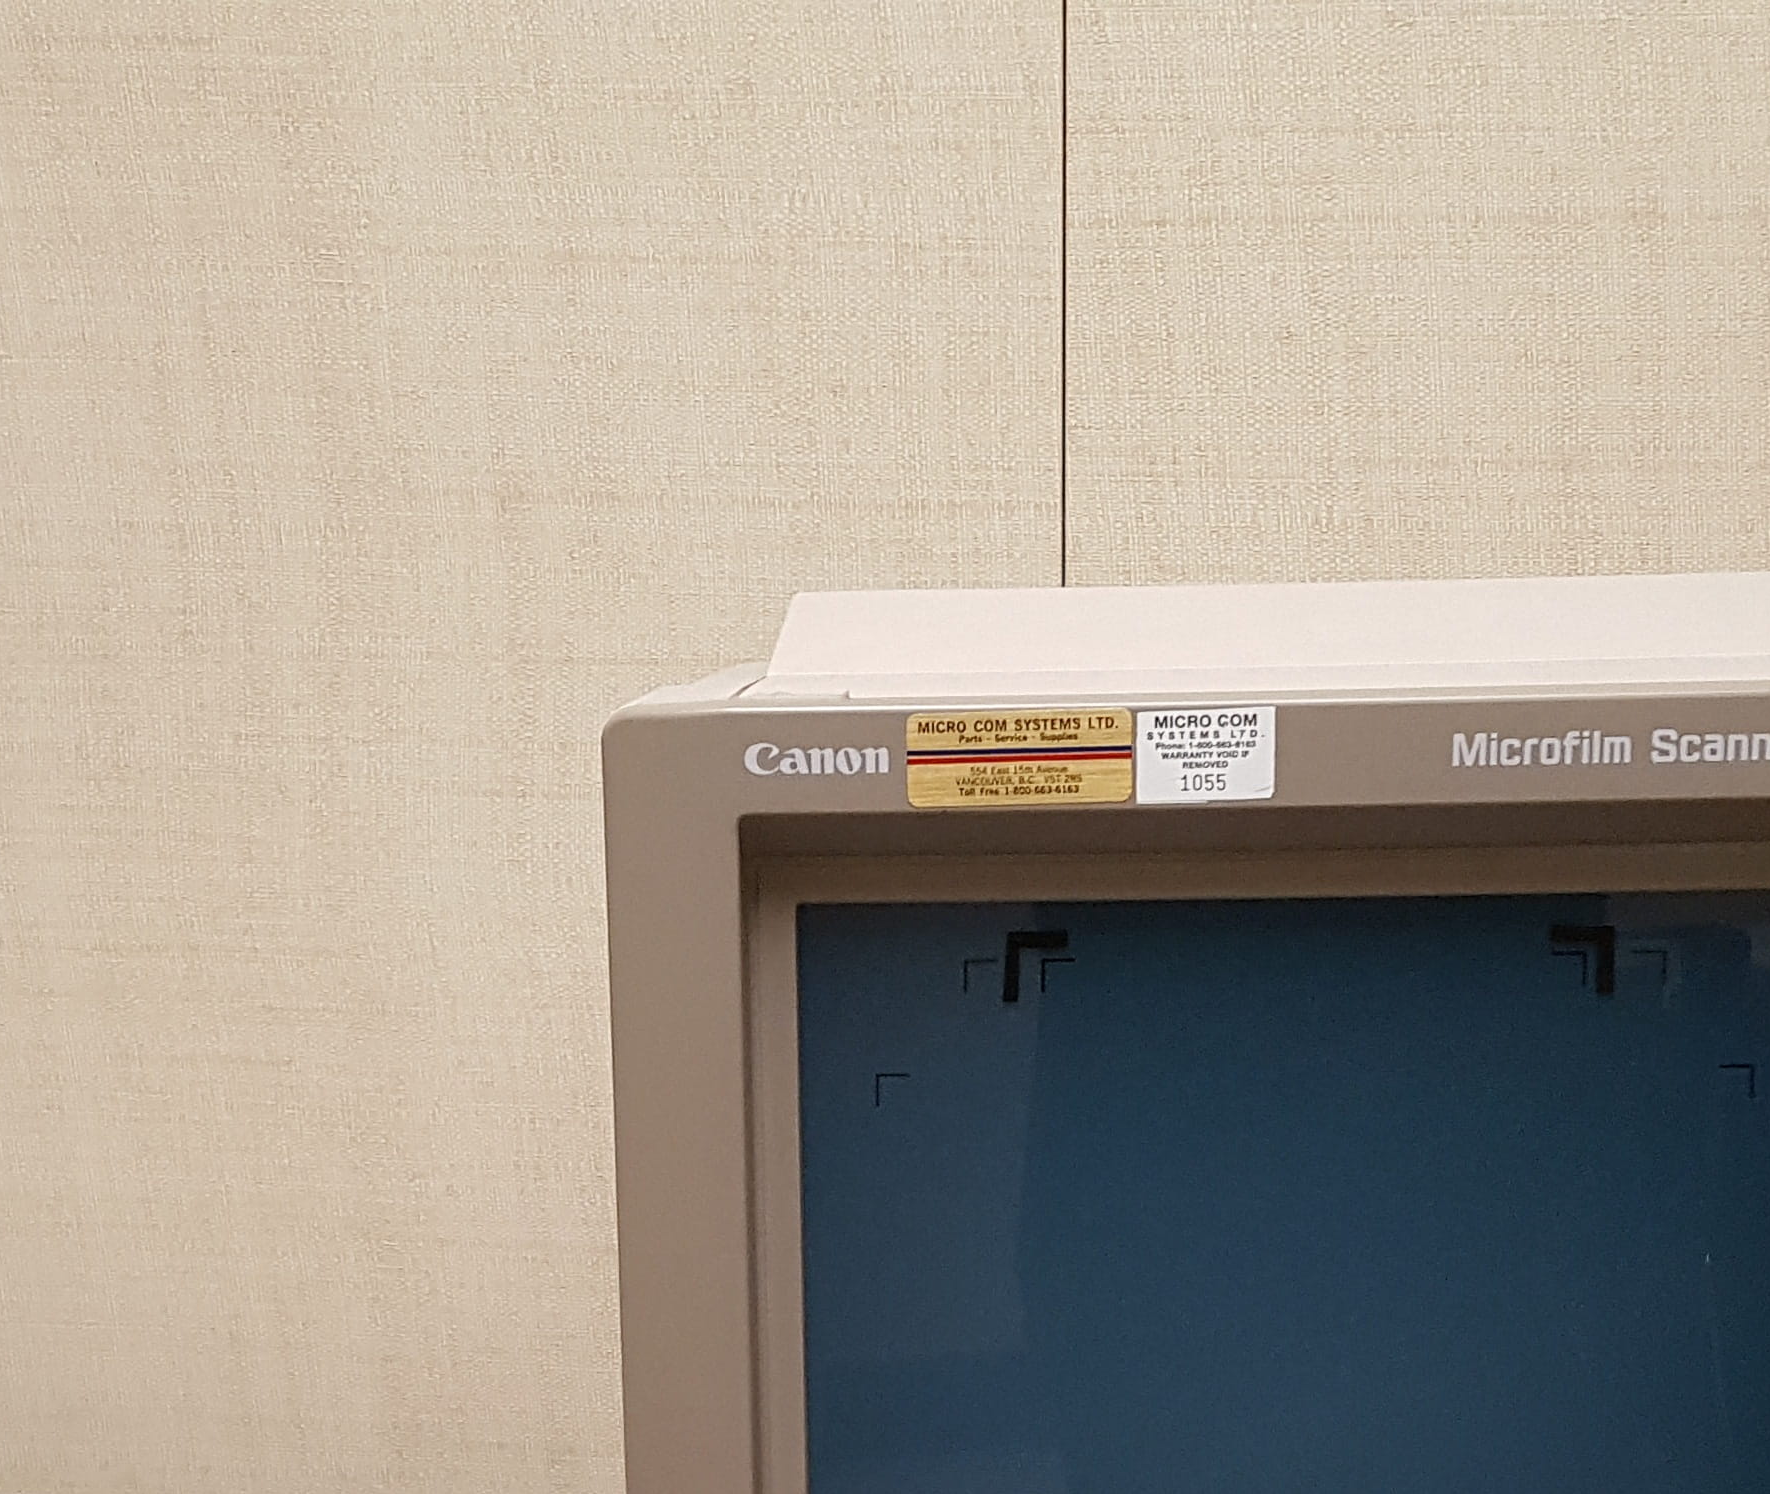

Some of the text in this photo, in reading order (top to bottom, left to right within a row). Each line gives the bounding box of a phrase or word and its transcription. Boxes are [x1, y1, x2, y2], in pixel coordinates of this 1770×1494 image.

[918, 716, 1119, 734] MICRO COM SYSTEMS LTD.
[1155, 713, 1257, 728] MICRO COM
[1161, 750, 1249, 760] WARRANTY VOID IF
[1452, 730, 1631, 767] Microfilm
[744, 742, 889, 776] Canon
[1182, 760, 1229, 769] REMOVED
[1181, 773, 1227, 792] 1055
